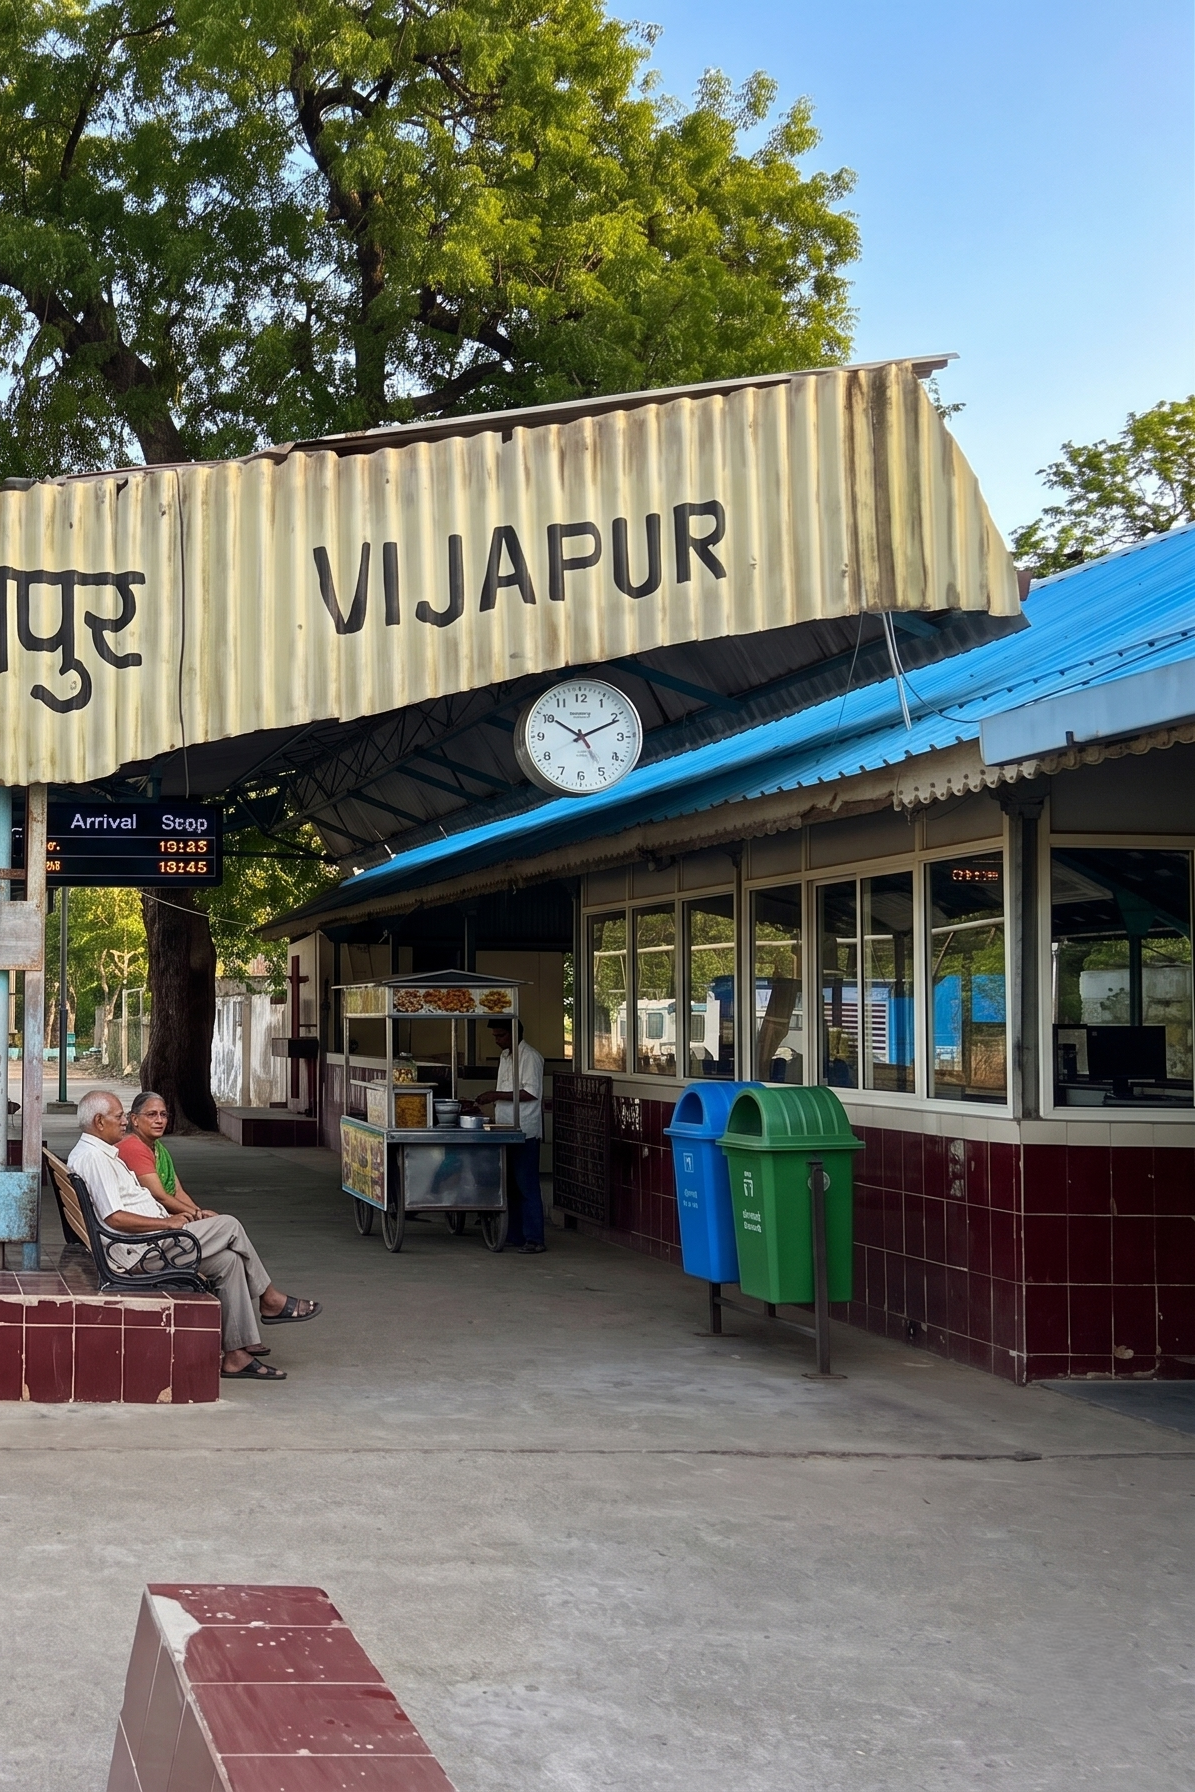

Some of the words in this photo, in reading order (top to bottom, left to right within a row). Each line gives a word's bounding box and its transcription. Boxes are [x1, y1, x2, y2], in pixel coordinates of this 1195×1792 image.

[312, 499, 727, 635] VIJAPUR
[556, 698, 566, 708] 11
[575, 693, 588, 703] 12
[537, 732, 545, 741] 9
[616, 732, 625, 742] 3
[557, 766, 565, 775] 7
[598, 767, 606, 776] 5
[70, 813, 137, 830] Arrival
[161, 814, 208, 834] Stop
